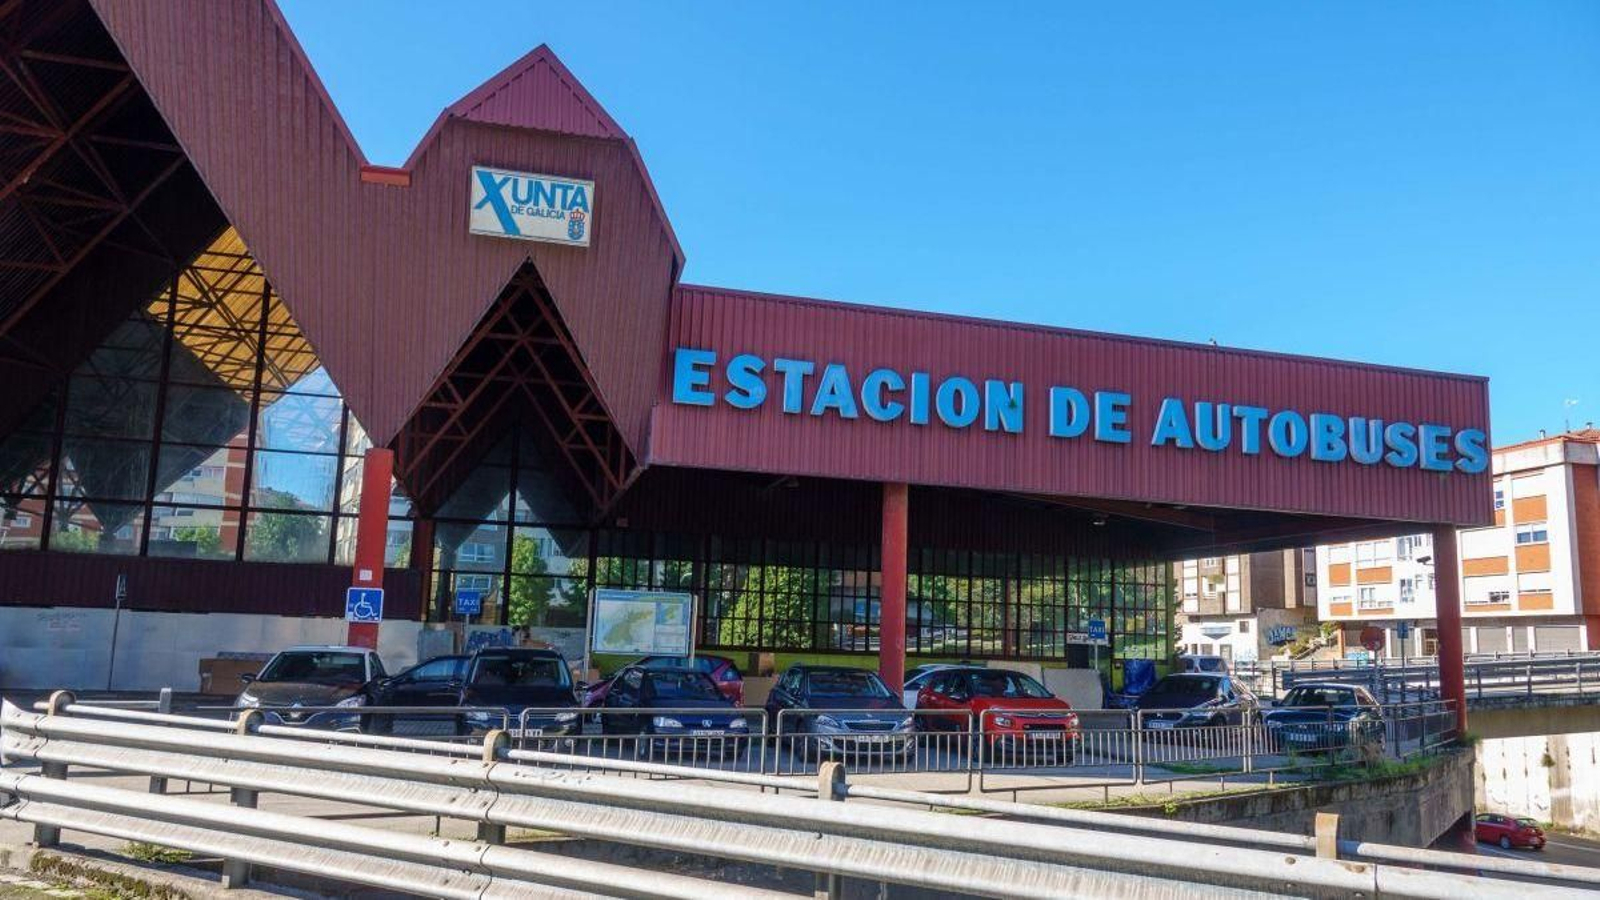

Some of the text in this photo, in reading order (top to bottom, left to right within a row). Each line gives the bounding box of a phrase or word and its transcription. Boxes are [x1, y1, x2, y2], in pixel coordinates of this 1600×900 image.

[474, 170, 589, 235] XUNTA
[511, 205, 565, 220] DE GALICIA
[672, 347, 1489, 475] ESTACION DE AUTOBUSES
